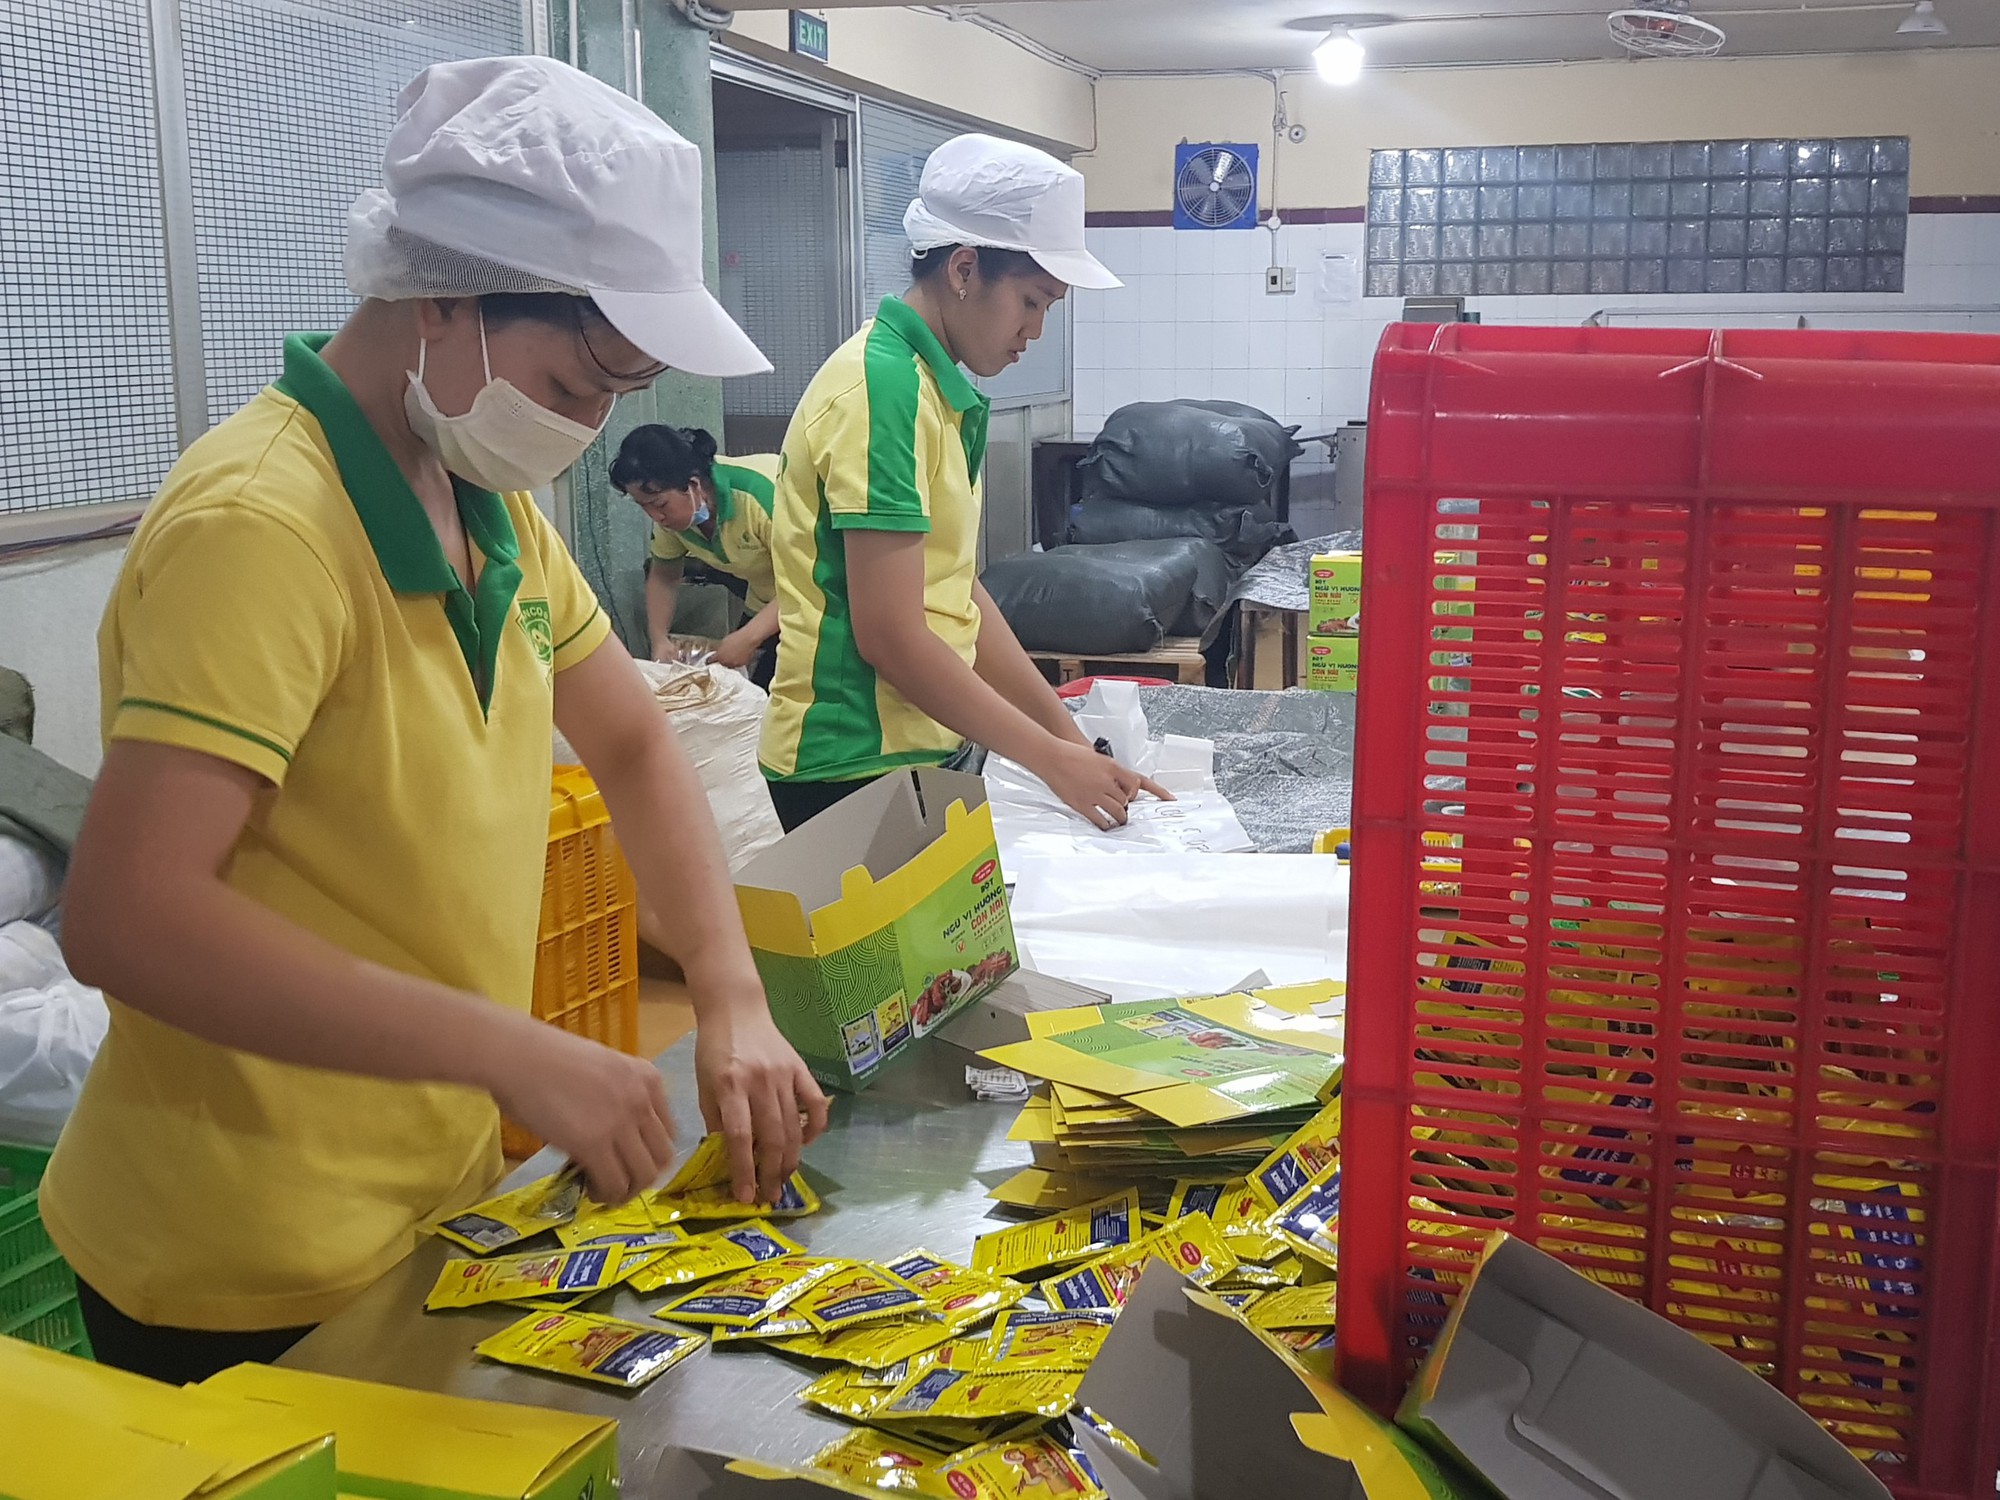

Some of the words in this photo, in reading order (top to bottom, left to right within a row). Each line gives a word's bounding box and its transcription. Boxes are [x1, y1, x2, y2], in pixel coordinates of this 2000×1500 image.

[798, 18, 825, 52] EXIT
[971, 910, 988, 930] CON
[989, 897, 1004, 915] NAI
